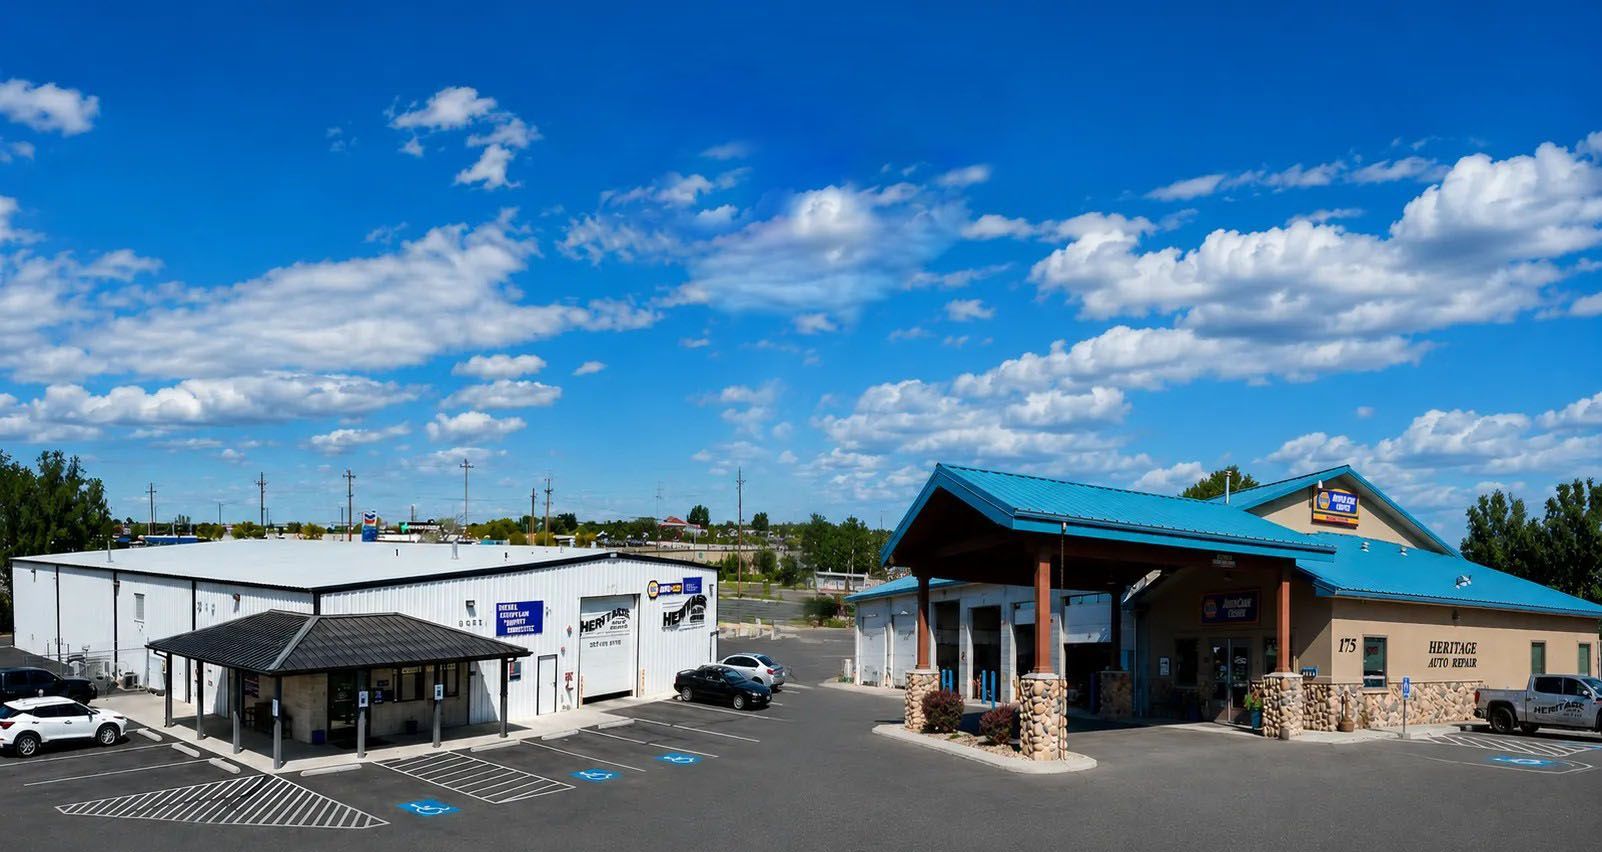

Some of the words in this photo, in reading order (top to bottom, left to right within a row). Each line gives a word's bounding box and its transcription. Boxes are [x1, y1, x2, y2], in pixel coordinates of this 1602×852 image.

[1338, 638, 1357, 653] 175
[1428, 640, 1477, 655] HERITAGE
[1428, 657, 1449, 668] AUTO
[1451, 657, 1477, 668] REPAIR
